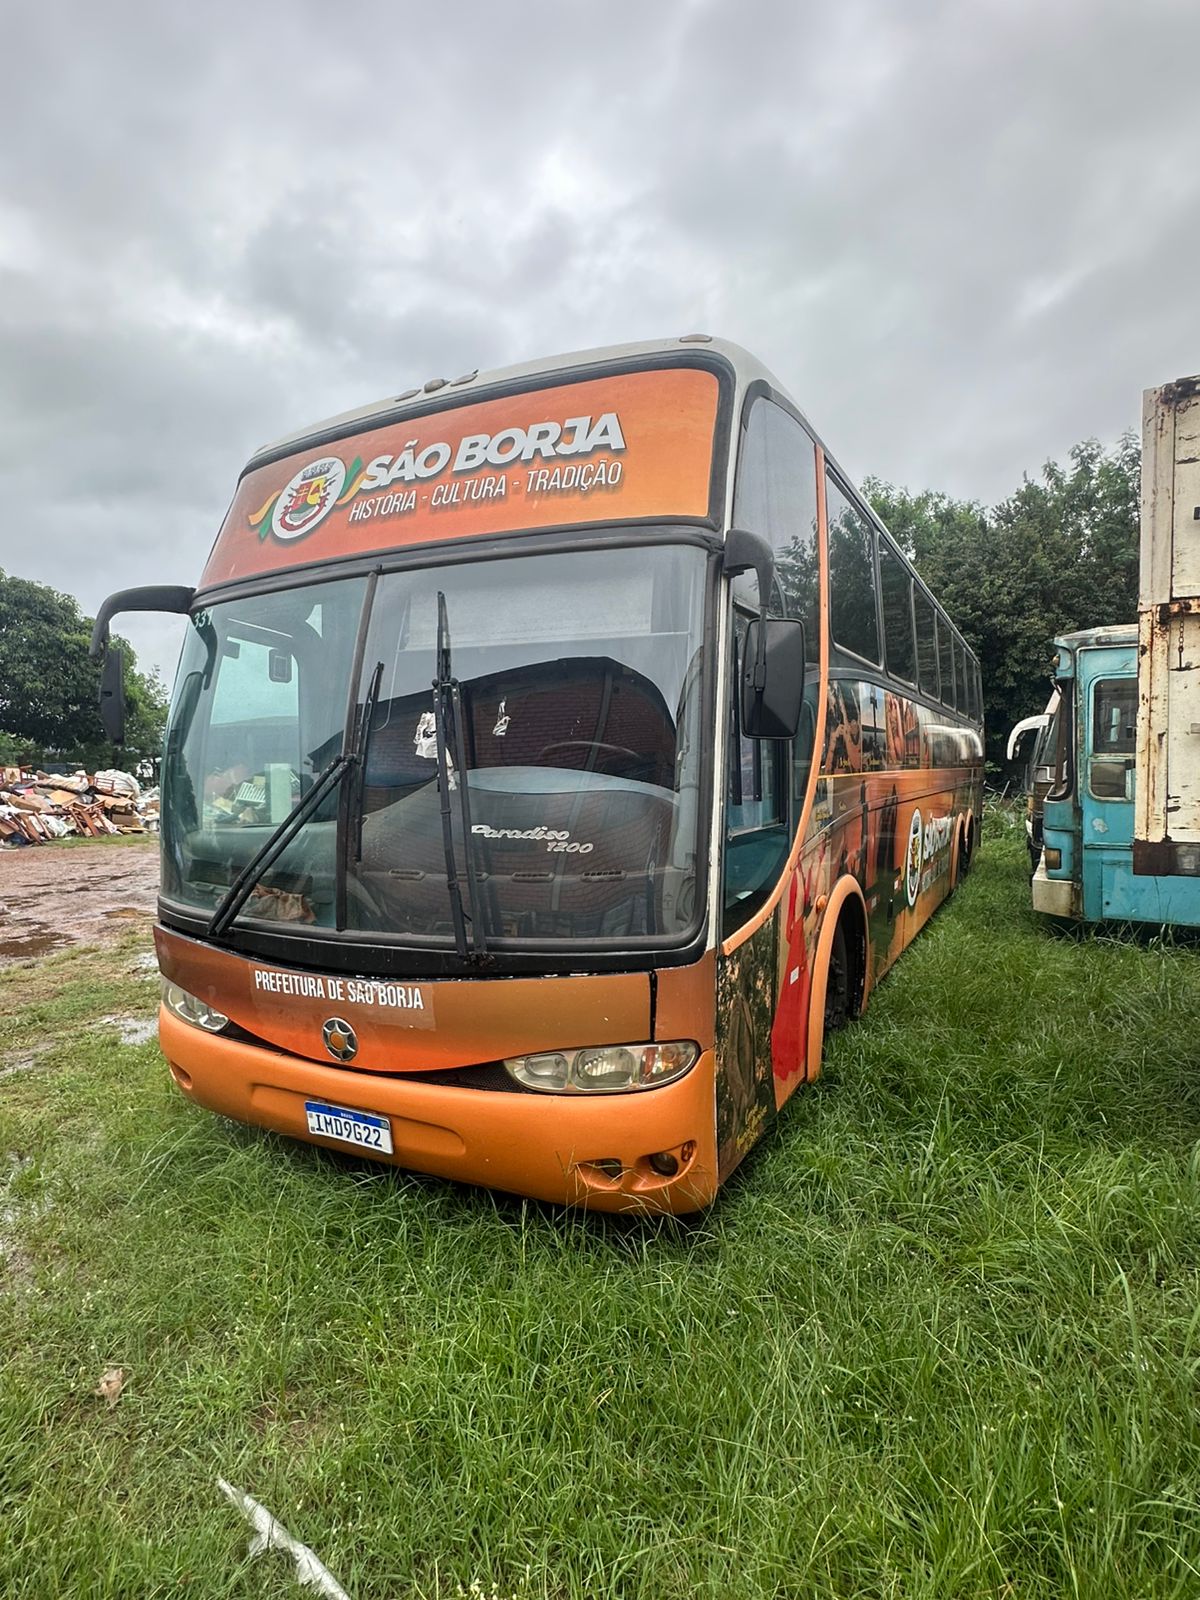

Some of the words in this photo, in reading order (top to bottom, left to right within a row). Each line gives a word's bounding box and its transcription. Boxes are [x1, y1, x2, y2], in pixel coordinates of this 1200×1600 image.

[360, 439, 452, 489] SÃO
[452, 412, 626, 472] BORJA
[348, 490, 417, 521] HISTÓRIA
[431, 474, 506, 506] CULTURA
[527, 459, 623, 493] TRADIÇÃO
[471, 824, 570, 842] Paradiso
[547, 841, 594, 854] 1200
[254, 970, 326, 999] PREFEITURA
[328, 979, 346, 1001] DE
[378, 985, 424, 1009] BORJA
[315, 1113, 383, 1148] IMD9G22
